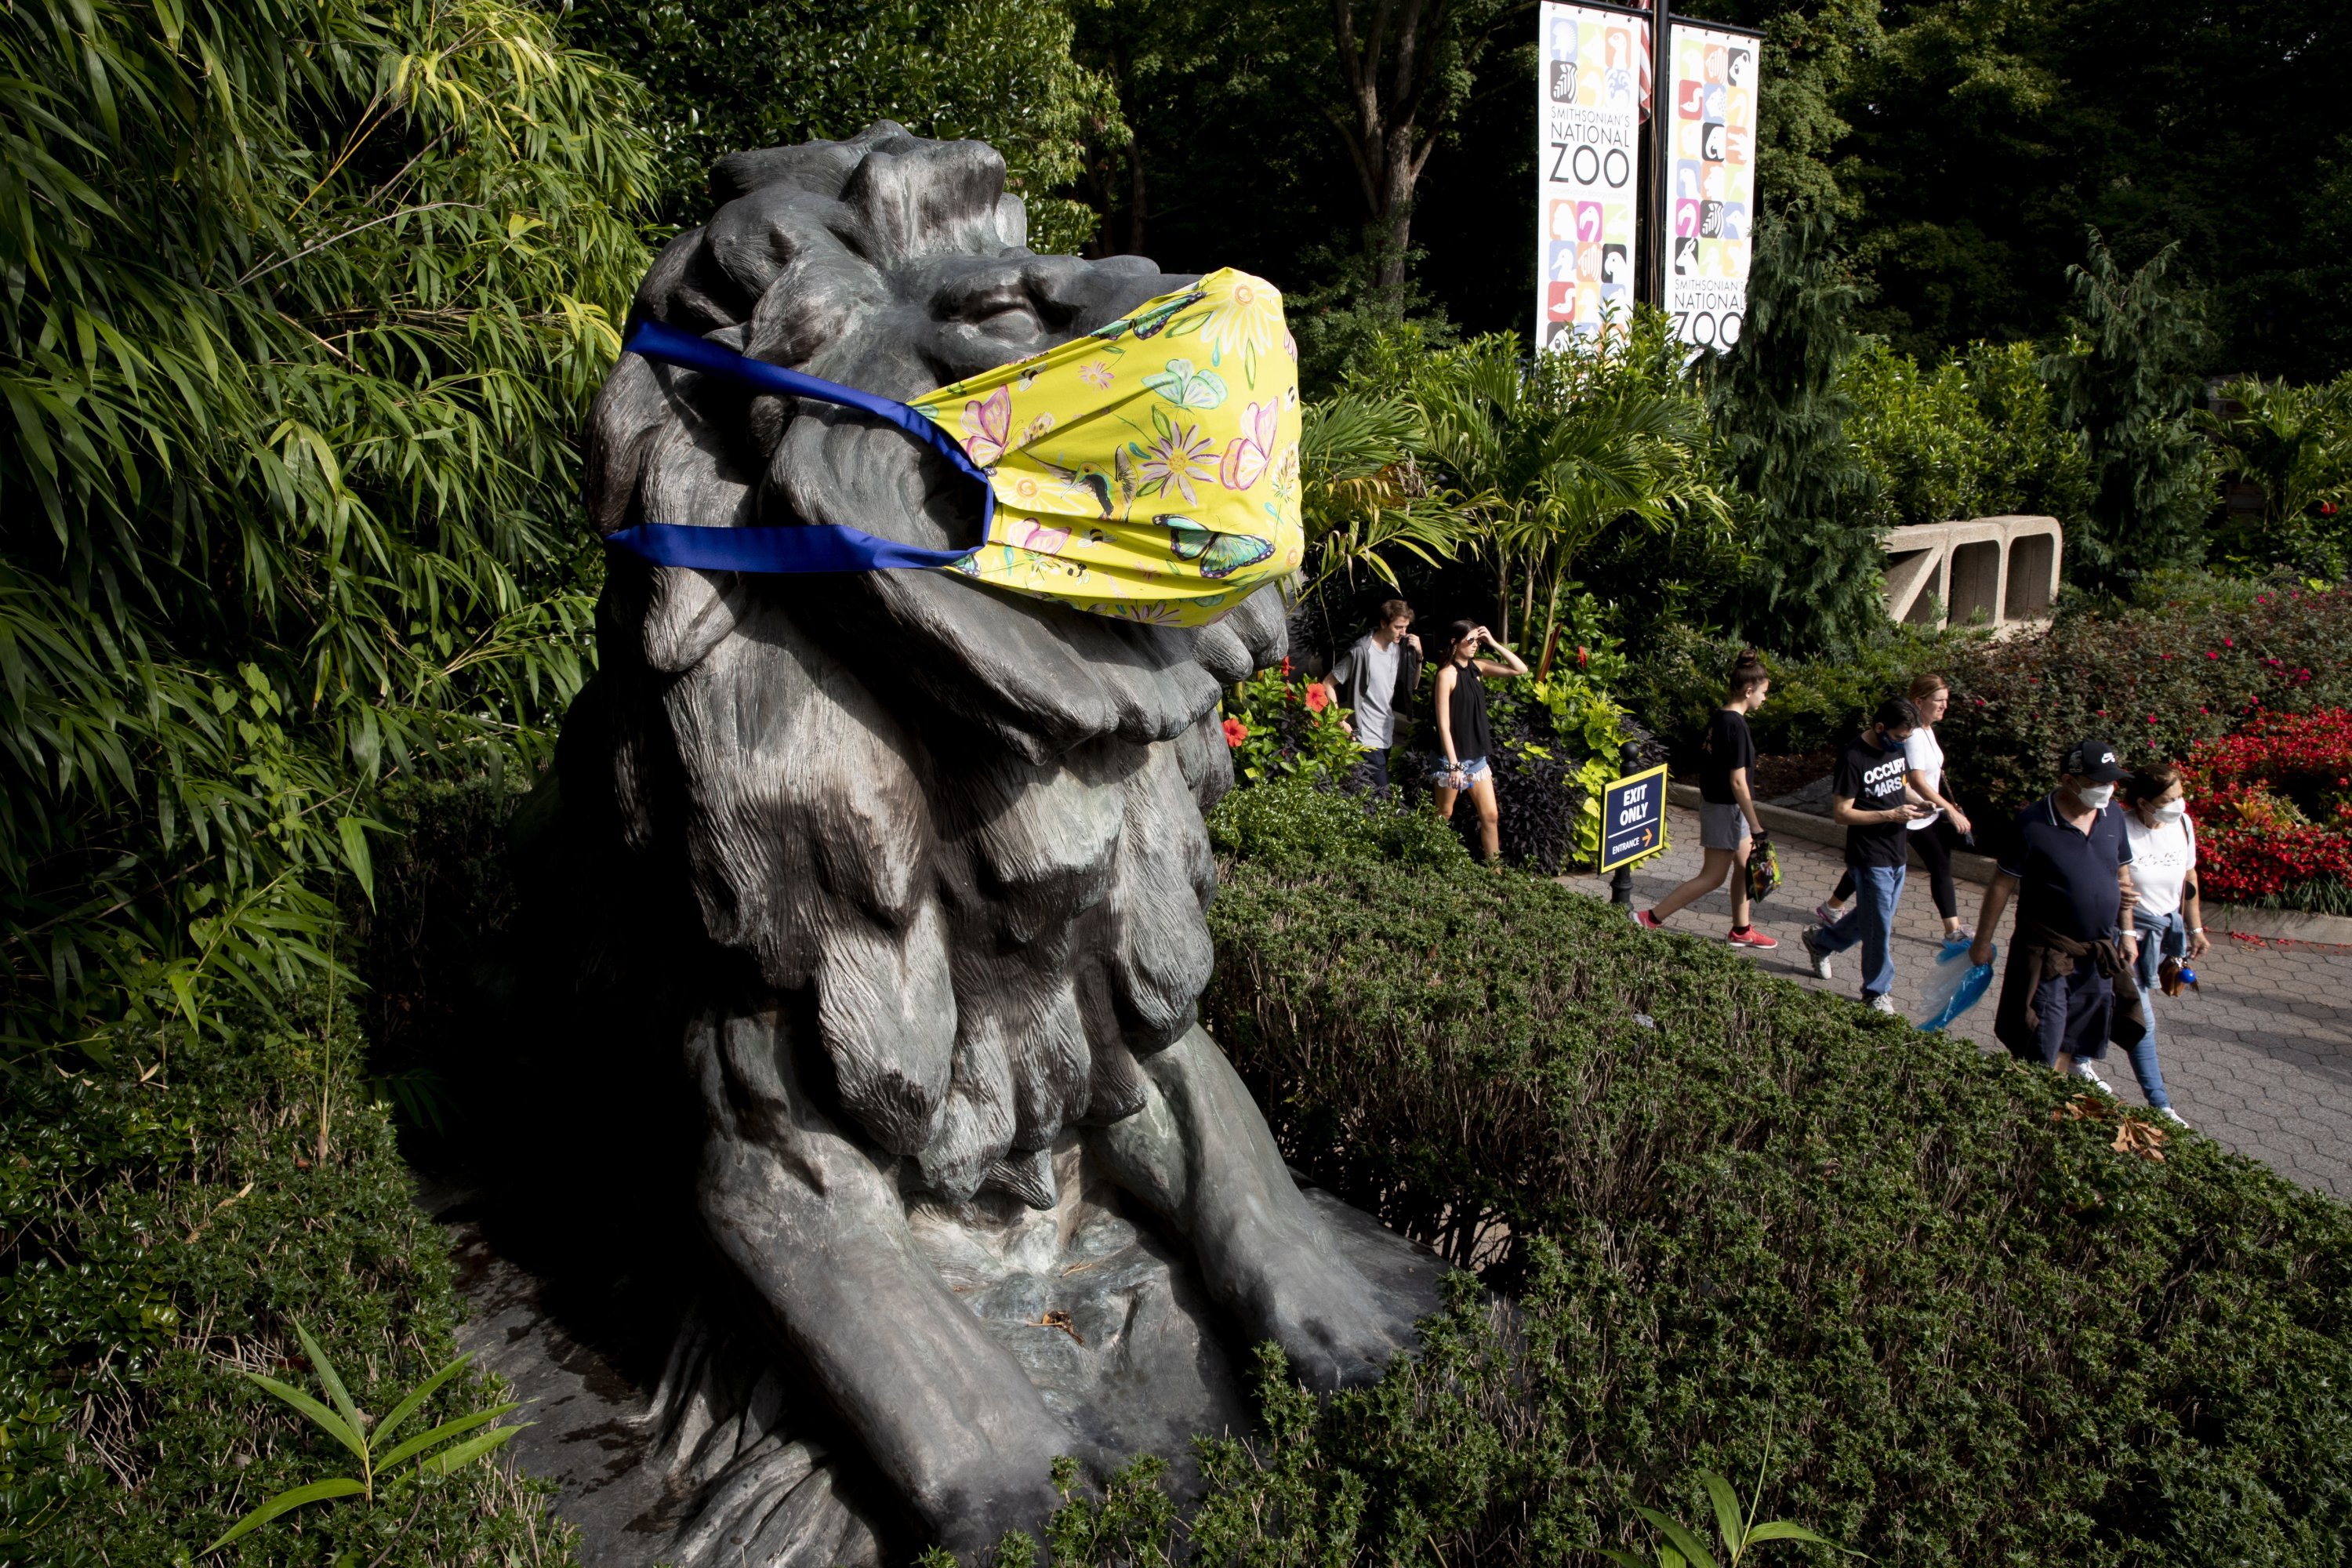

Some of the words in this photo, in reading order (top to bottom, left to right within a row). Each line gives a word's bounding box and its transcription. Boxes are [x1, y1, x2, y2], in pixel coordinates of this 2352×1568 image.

[1551, 106, 1630, 128] SMITHSONIAN'S
[1551, 121, 1630, 147] NATIONAL
[1548, 141, 1630, 189] ZOO
[1675, 278, 1744, 292] SMITHSONIAN'S
[1675, 292, 1744, 310] NATIONAL
[1864, 757, 1906, 784] OCCUPY
[1623, 783, 1648, 807] EXIT
[1864, 776, 1903, 797] MARS
[1619, 801, 1649, 826] ONLY
[1612, 837, 1640, 855] ENTRANCE
